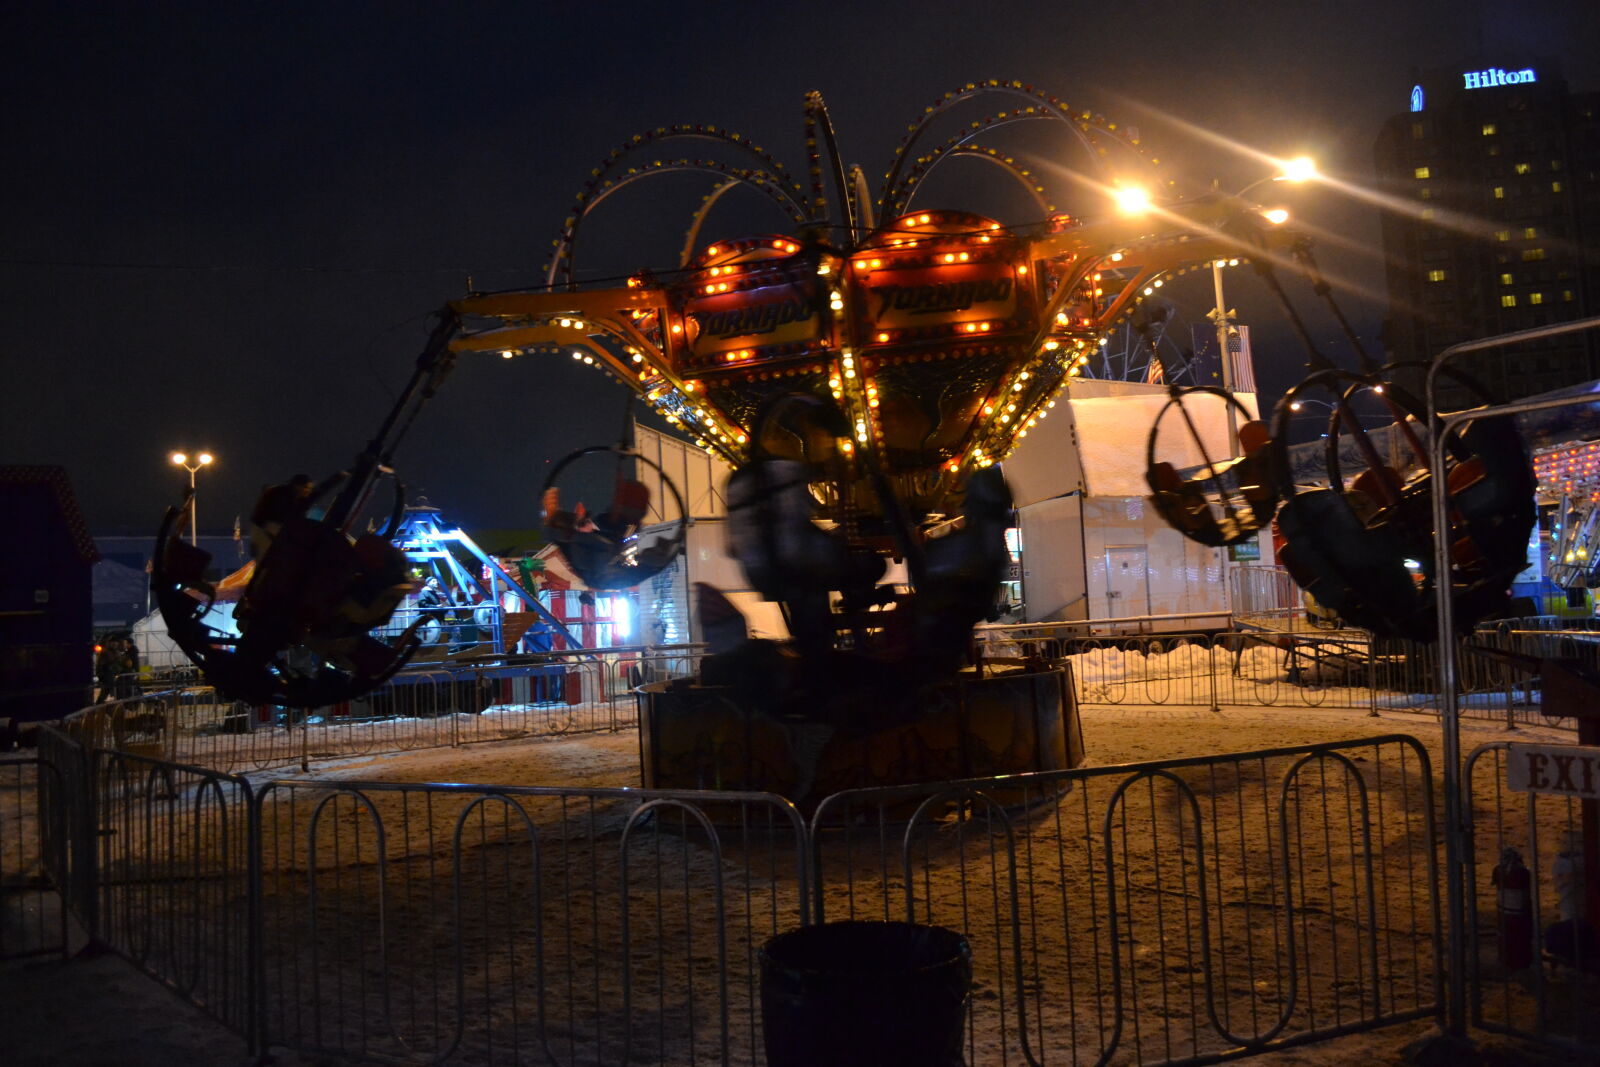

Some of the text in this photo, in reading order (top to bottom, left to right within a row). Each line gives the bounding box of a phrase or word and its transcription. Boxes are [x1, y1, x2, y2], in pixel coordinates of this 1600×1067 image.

[1463, 67, 1536, 89] Hilton
[870, 278, 1012, 322] TORNADO
[1525, 752, 1600, 794] EXI
